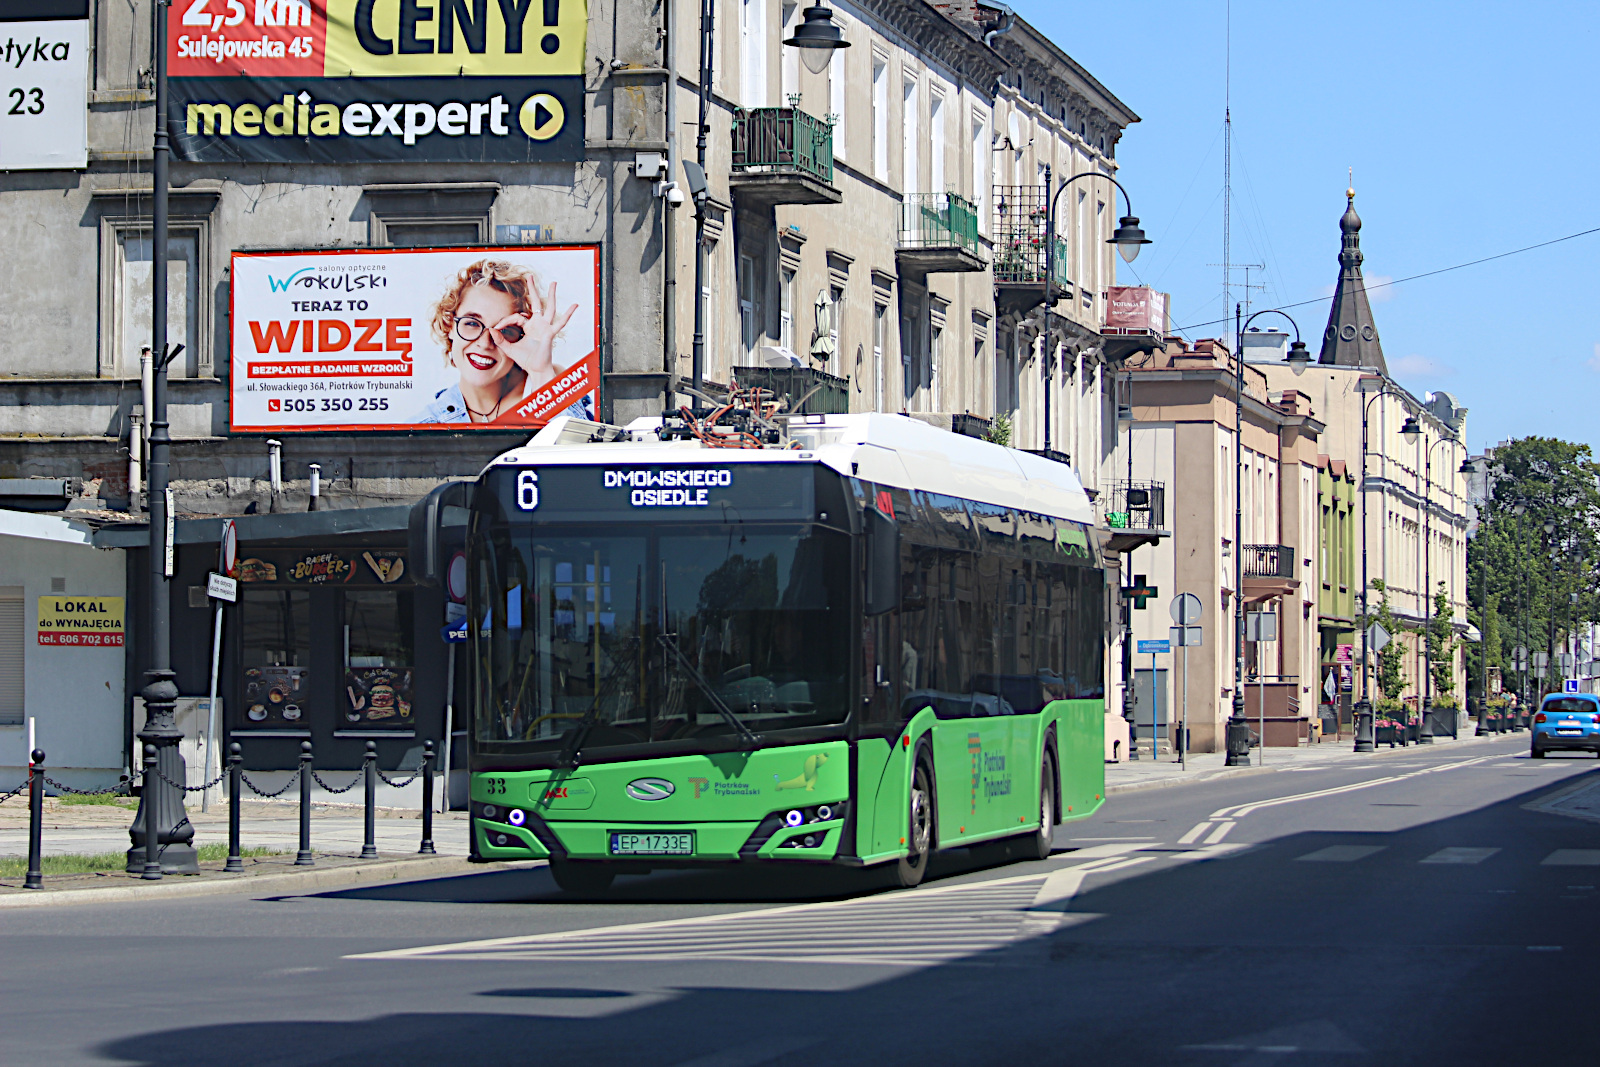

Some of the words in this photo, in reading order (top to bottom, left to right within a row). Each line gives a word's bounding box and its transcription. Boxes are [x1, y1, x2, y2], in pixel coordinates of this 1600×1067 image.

[182, 0, 246, 32] 2,5
[254, 0, 311, 27] km
[354, 0, 560, 55] CENY!
[177, 35, 285, 62] Sulejowska
[288, 36, 313, 58] 45
[8, 88, 45, 115] 23
[186, 91, 508, 144] mediaexpert
[318, 265, 345, 273] salony
[348, 264, 386, 273] optyczne
[291, 300, 343, 312] TERAZ
[347, 299, 369, 311] TO
[248, 317, 413, 361] WIDZĘ
[251, 364, 312, 375] BEZPŁATNE
[312, 364, 359, 374] BADANIE
[361, 363, 409, 373] WZROKU
[247, 382, 258, 392] ul.
[259, 382, 308, 393] Słowackiego
[310, 381, 327, 392] 36A,
[329, 381, 365, 391] Piotrków
[366, 380, 413, 392] Trybunalski
[516, 389, 553, 418] TWÓJ
[552, 362, 589, 395] NOWY
[283, 399, 316, 412] 505
[321, 398, 353, 411] 350
[358, 397, 389, 411] 255
[534, 400, 557, 419] SALON
[556, 377, 589, 403] OPTYCZNY
[604, 470, 732, 487] DMOWSKIEGO
[517, 470, 539, 510] 6
[631, 489, 709, 506] OSIEDLE
[295, 560, 343, 579] BURGER
[55, 601, 107, 613] LOKAL
[39, 619, 53, 627] do
[55, 619, 122, 630] WYNAJĘCIA
[39, 635, 57, 643] tel.
[59, 635, 79, 643] 606
[81, 635, 101, 644] 702
[103, 635, 123, 644] 615
[1568, 681, 1576, 691] L
[487, 777, 506, 795] 33
[714, 788, 760, 796] Trybunalski
[621, 835, 639, 849] EP
[645, 835, 688, 849] 1733E
